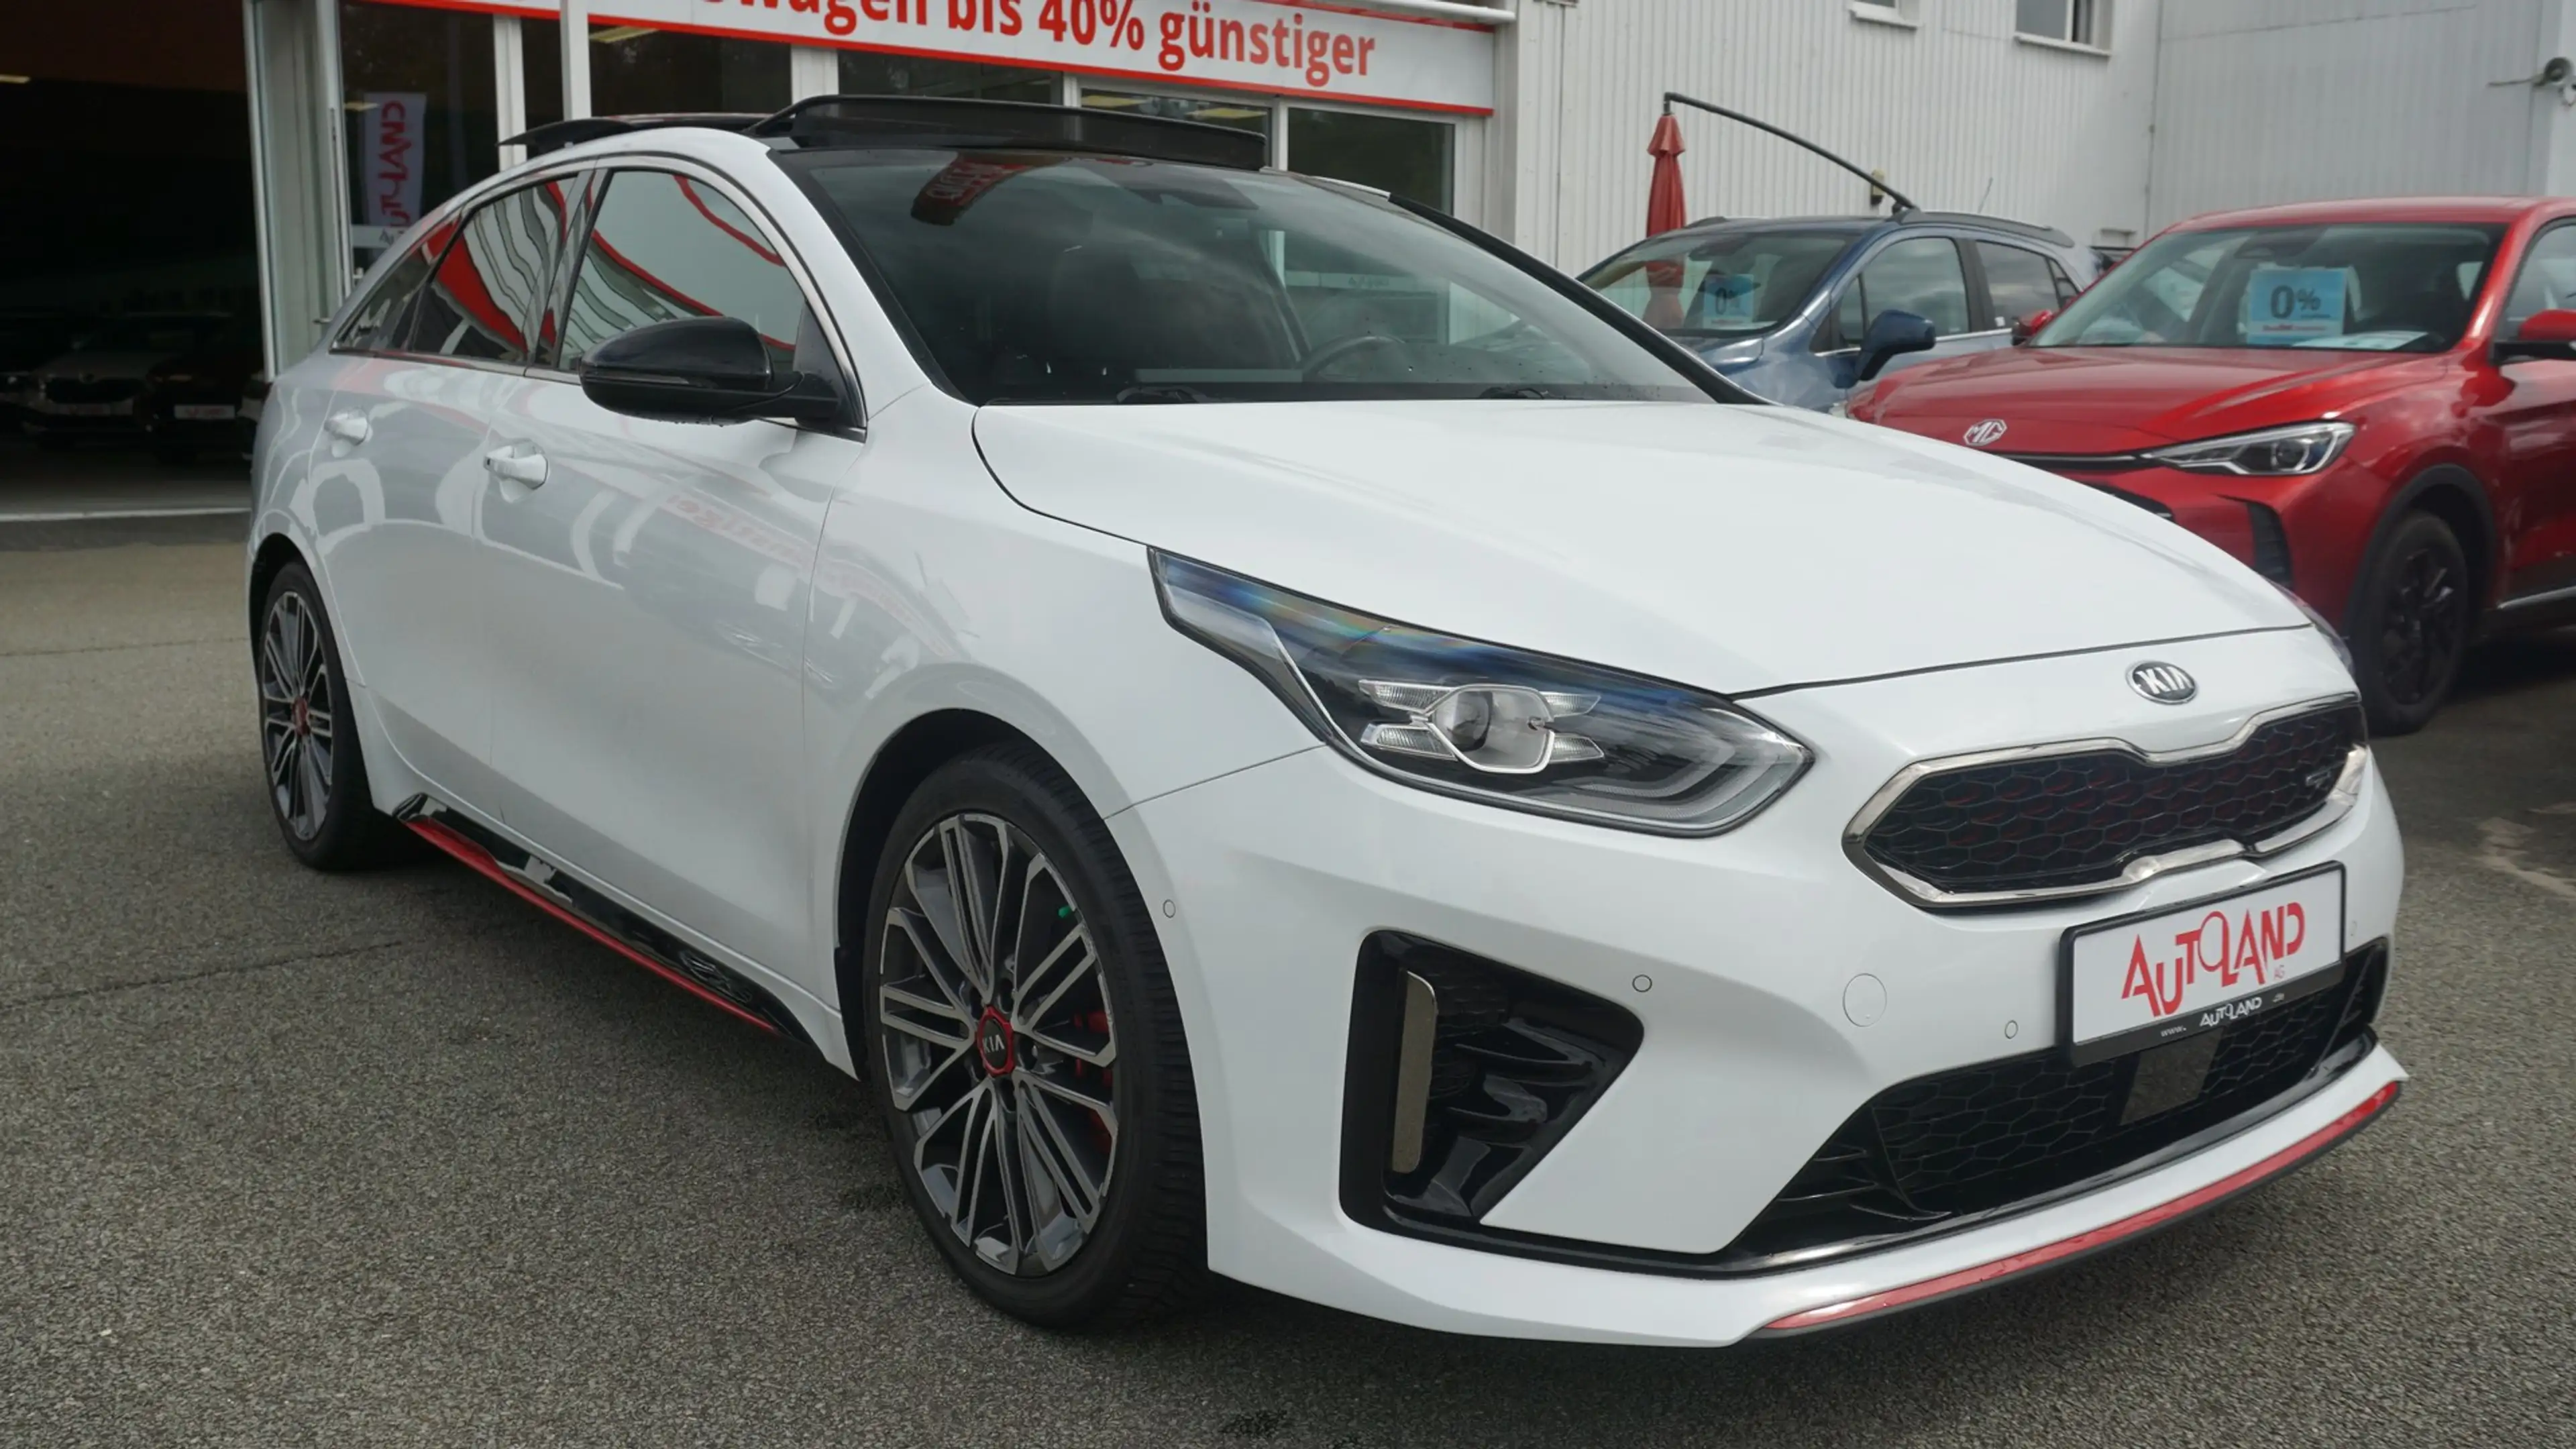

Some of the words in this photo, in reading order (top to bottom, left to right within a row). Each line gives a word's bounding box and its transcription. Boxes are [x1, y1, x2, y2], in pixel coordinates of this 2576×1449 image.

[1038, 0, 1144, 50] 40%
[1158, 0, 1375, 87] günstiger
[2270, 284, 2322, 319] 0%
[1966, 421, 2004, 443] MG
[2135, 666, 2194, 694] KIA
[2121, 902, 2306, 1018] AUTOLAND
[2199, 997, 2263, 1028] AUTOLAND
[982, 1034, 1005, 1053] KIA
